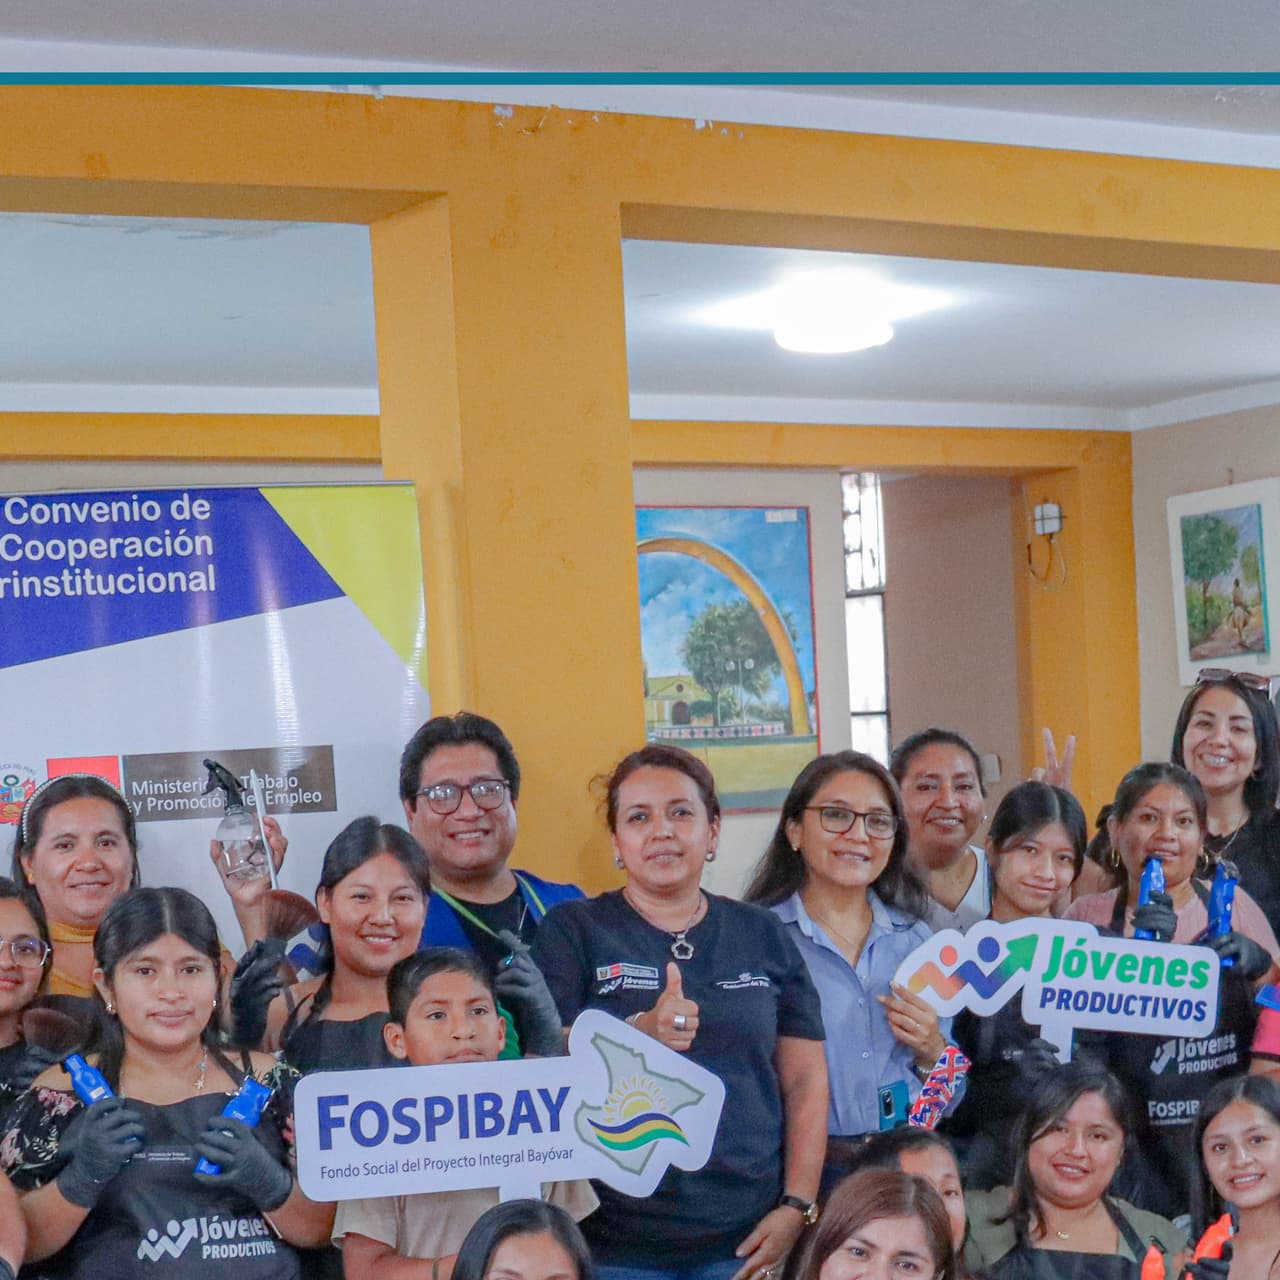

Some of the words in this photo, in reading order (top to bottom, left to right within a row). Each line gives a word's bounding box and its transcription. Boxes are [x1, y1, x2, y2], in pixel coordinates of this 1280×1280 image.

[3, 494, 162, 525] Convenio
[169, 492, 211, 521] de
[239, 773, 298, 793] Tabajo
[265, 788, 322, 808] Empleo
[1040, 935, 1212, 990] Jóvenes
[1039, 986, 1208, 1022] PRODUCTIVOS
[317, 1086, 572, 1151] FOSPIBAY
[1148, 1099, 1200, 1118] FOSPIB
[320, 1163, 361, 1180] Fondo
[363, 1159, 399, 1177] Social
[401, 1157, 420, 1174] del
[423, 1153, 476, 1173] Proyecto
[479, 1149, 525, 1168] Integral
[528, 1146, 575, 1163] Bayóvar
[201, 1239, 276, 1260] PRODUCTIVOS
